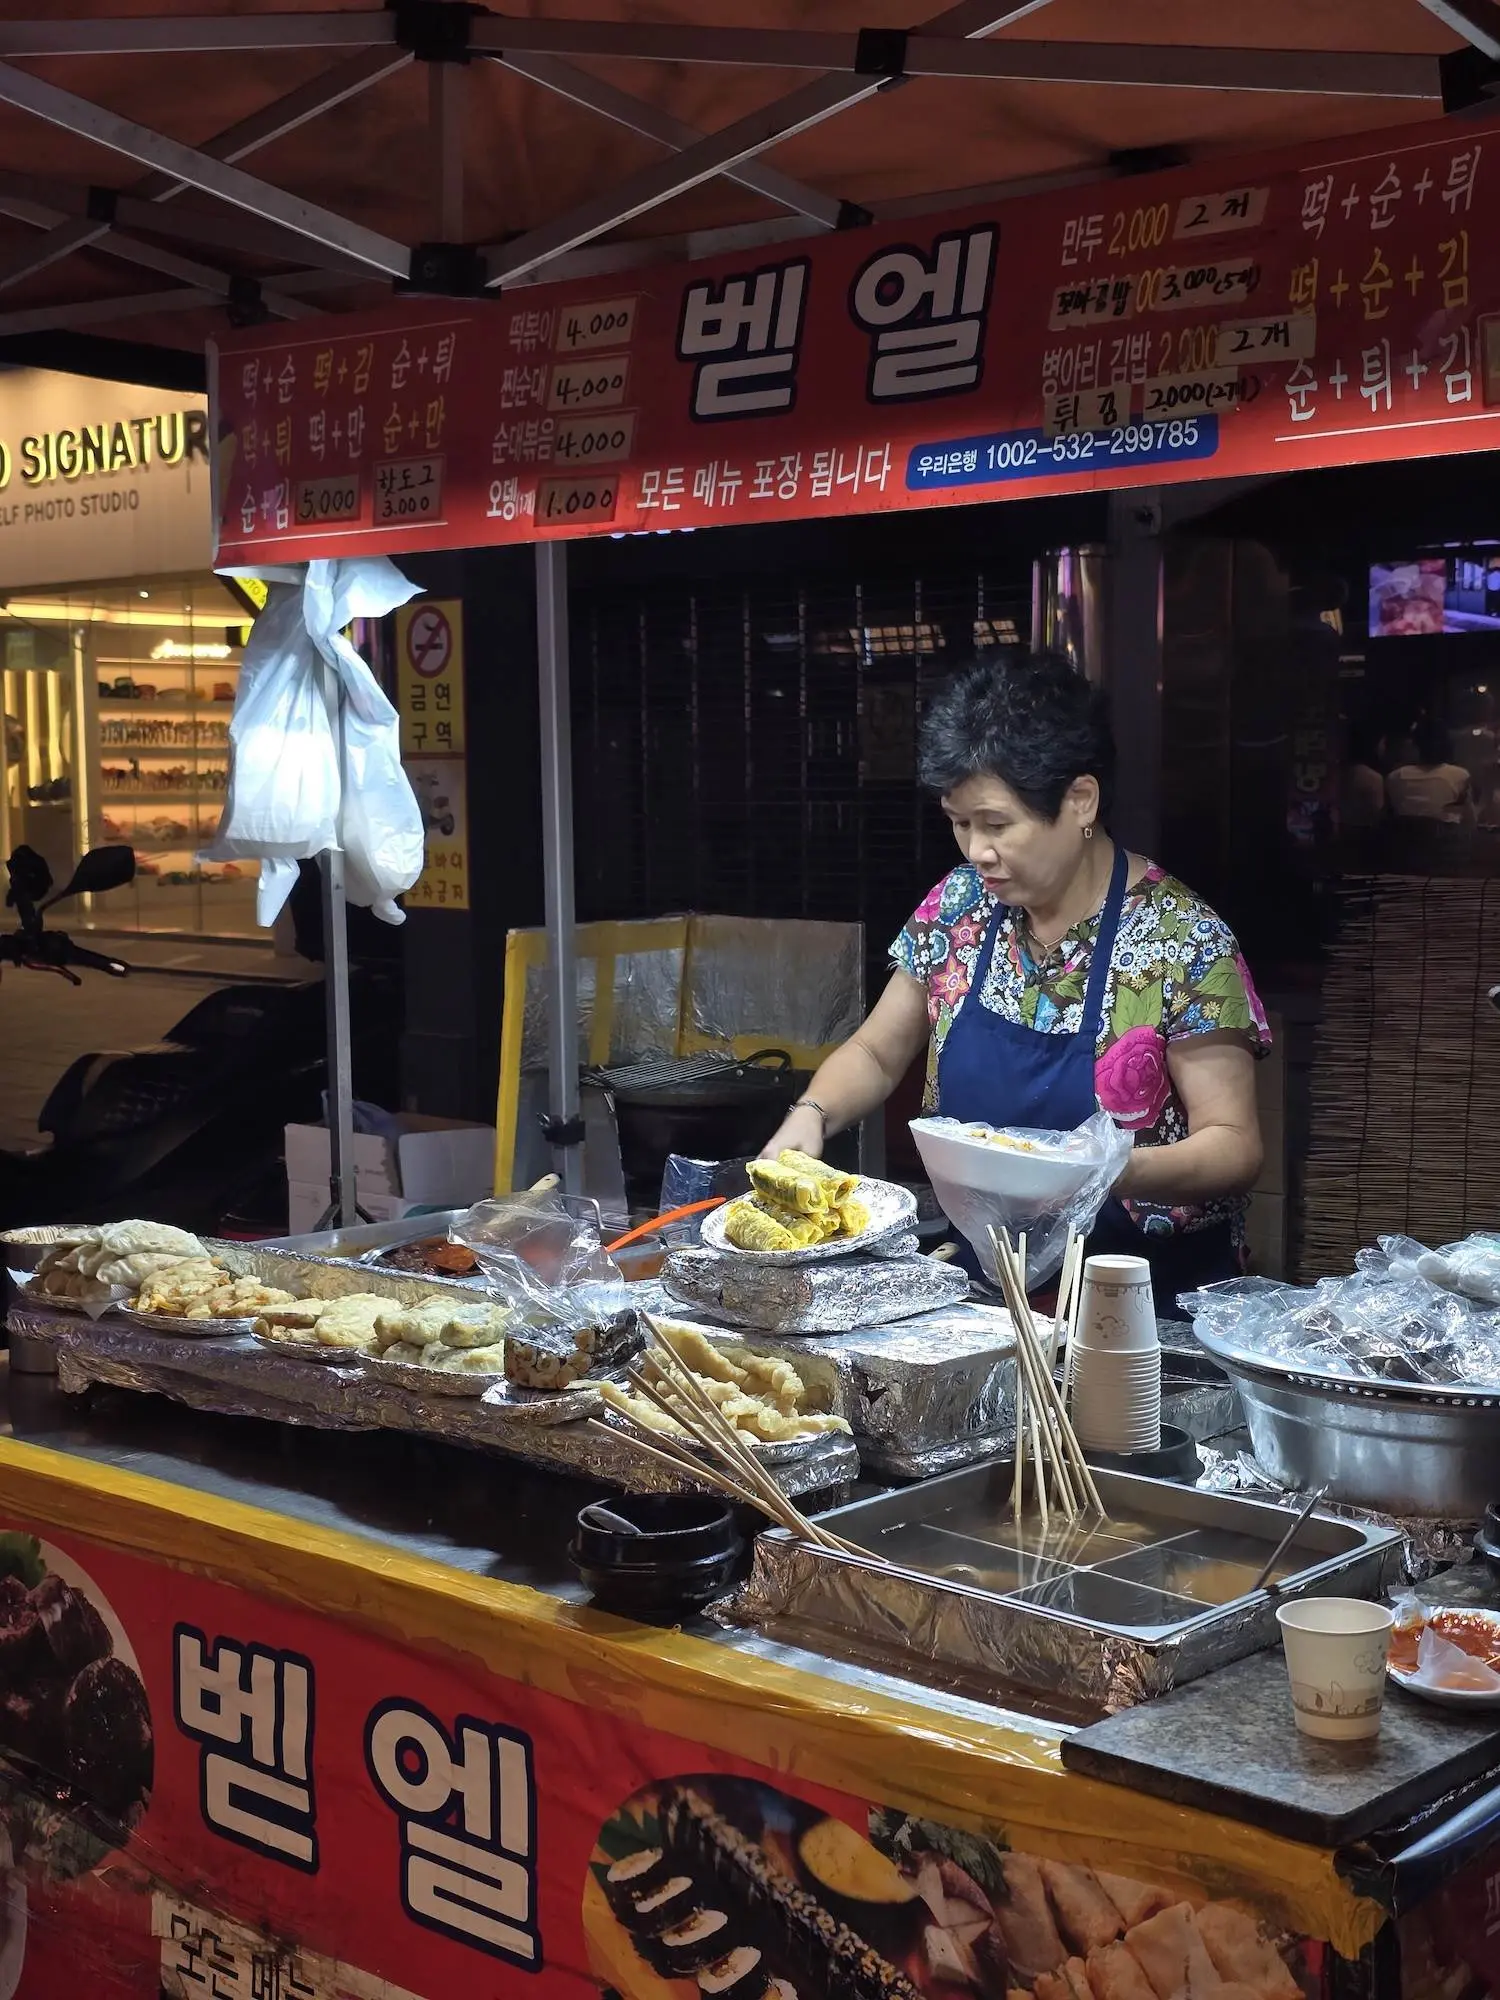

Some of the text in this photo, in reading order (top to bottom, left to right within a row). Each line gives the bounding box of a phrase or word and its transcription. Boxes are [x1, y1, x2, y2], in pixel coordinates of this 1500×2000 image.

[1061, 203, 1169, 266] 만두 2,000
[509, 307, 556, 354] 떡볶이
[501, 364, 549, 409] 찐순대
[1042, 338, 1101, 397] 병아리
[1110, 331, 1152, 385] 김밥
[492, 417, 555, 465] 순대볶음
[917, 420, 1199, 479] 우리은행 1002-532-299785
[377, 465, 434, 498] 핫도그
[637, 441, 892, 510] 모든 메뉴 포장 됩니다
[24, 497, 75, 524] PHOTO
[81, 489, 140, 516] STUDIO
[411, 684, 450, 711] 금연
[411, 722, 452, 750] 구역
